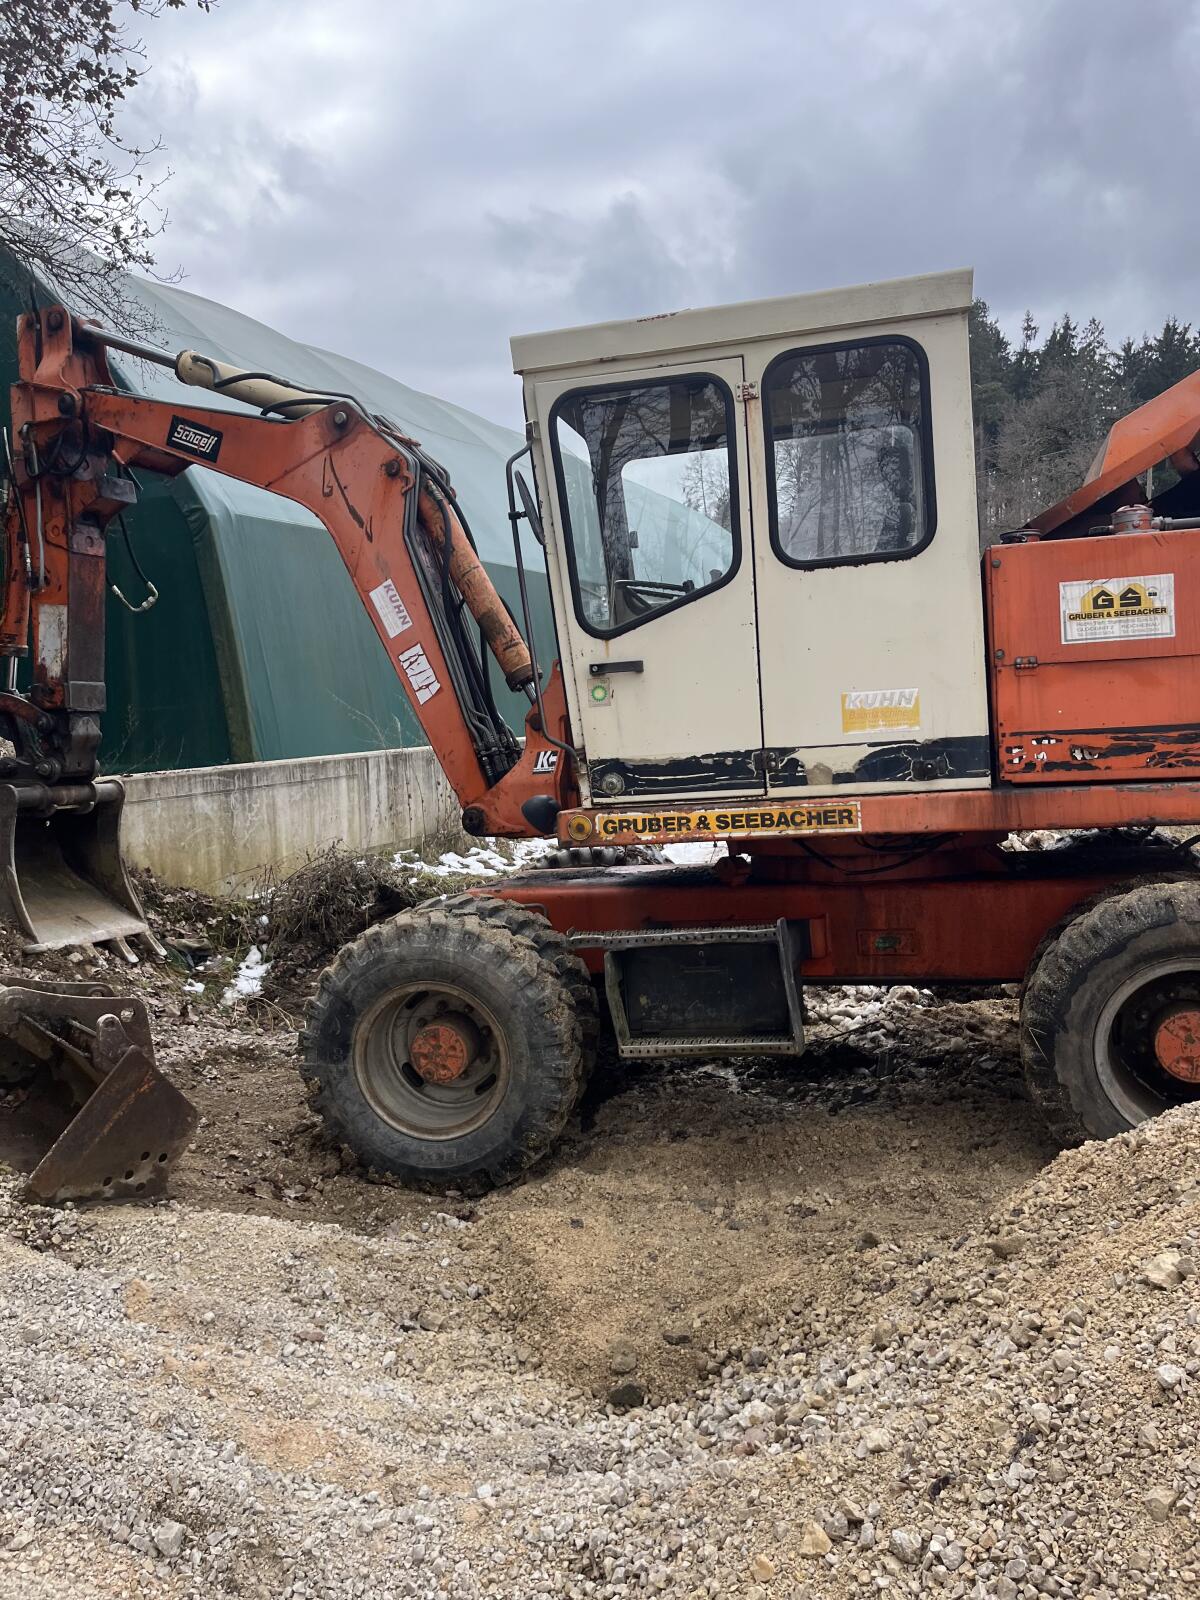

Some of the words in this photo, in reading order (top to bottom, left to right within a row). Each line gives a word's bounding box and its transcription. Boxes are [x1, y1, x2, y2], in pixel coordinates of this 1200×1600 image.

[383, 583, 411, 626] KUHN
[1068, 611, 1105, 621] GRUBER
[1106, 610, 1113, 618] &
[1114, 607, 1167, 617] SEEBACHER
[846, 689, 917, 708] KUHN
[602, 815, 692, 835] GRUBER
[696, 815, 711, 832] &
[715, 808, 853, 831] SEEBACHER
